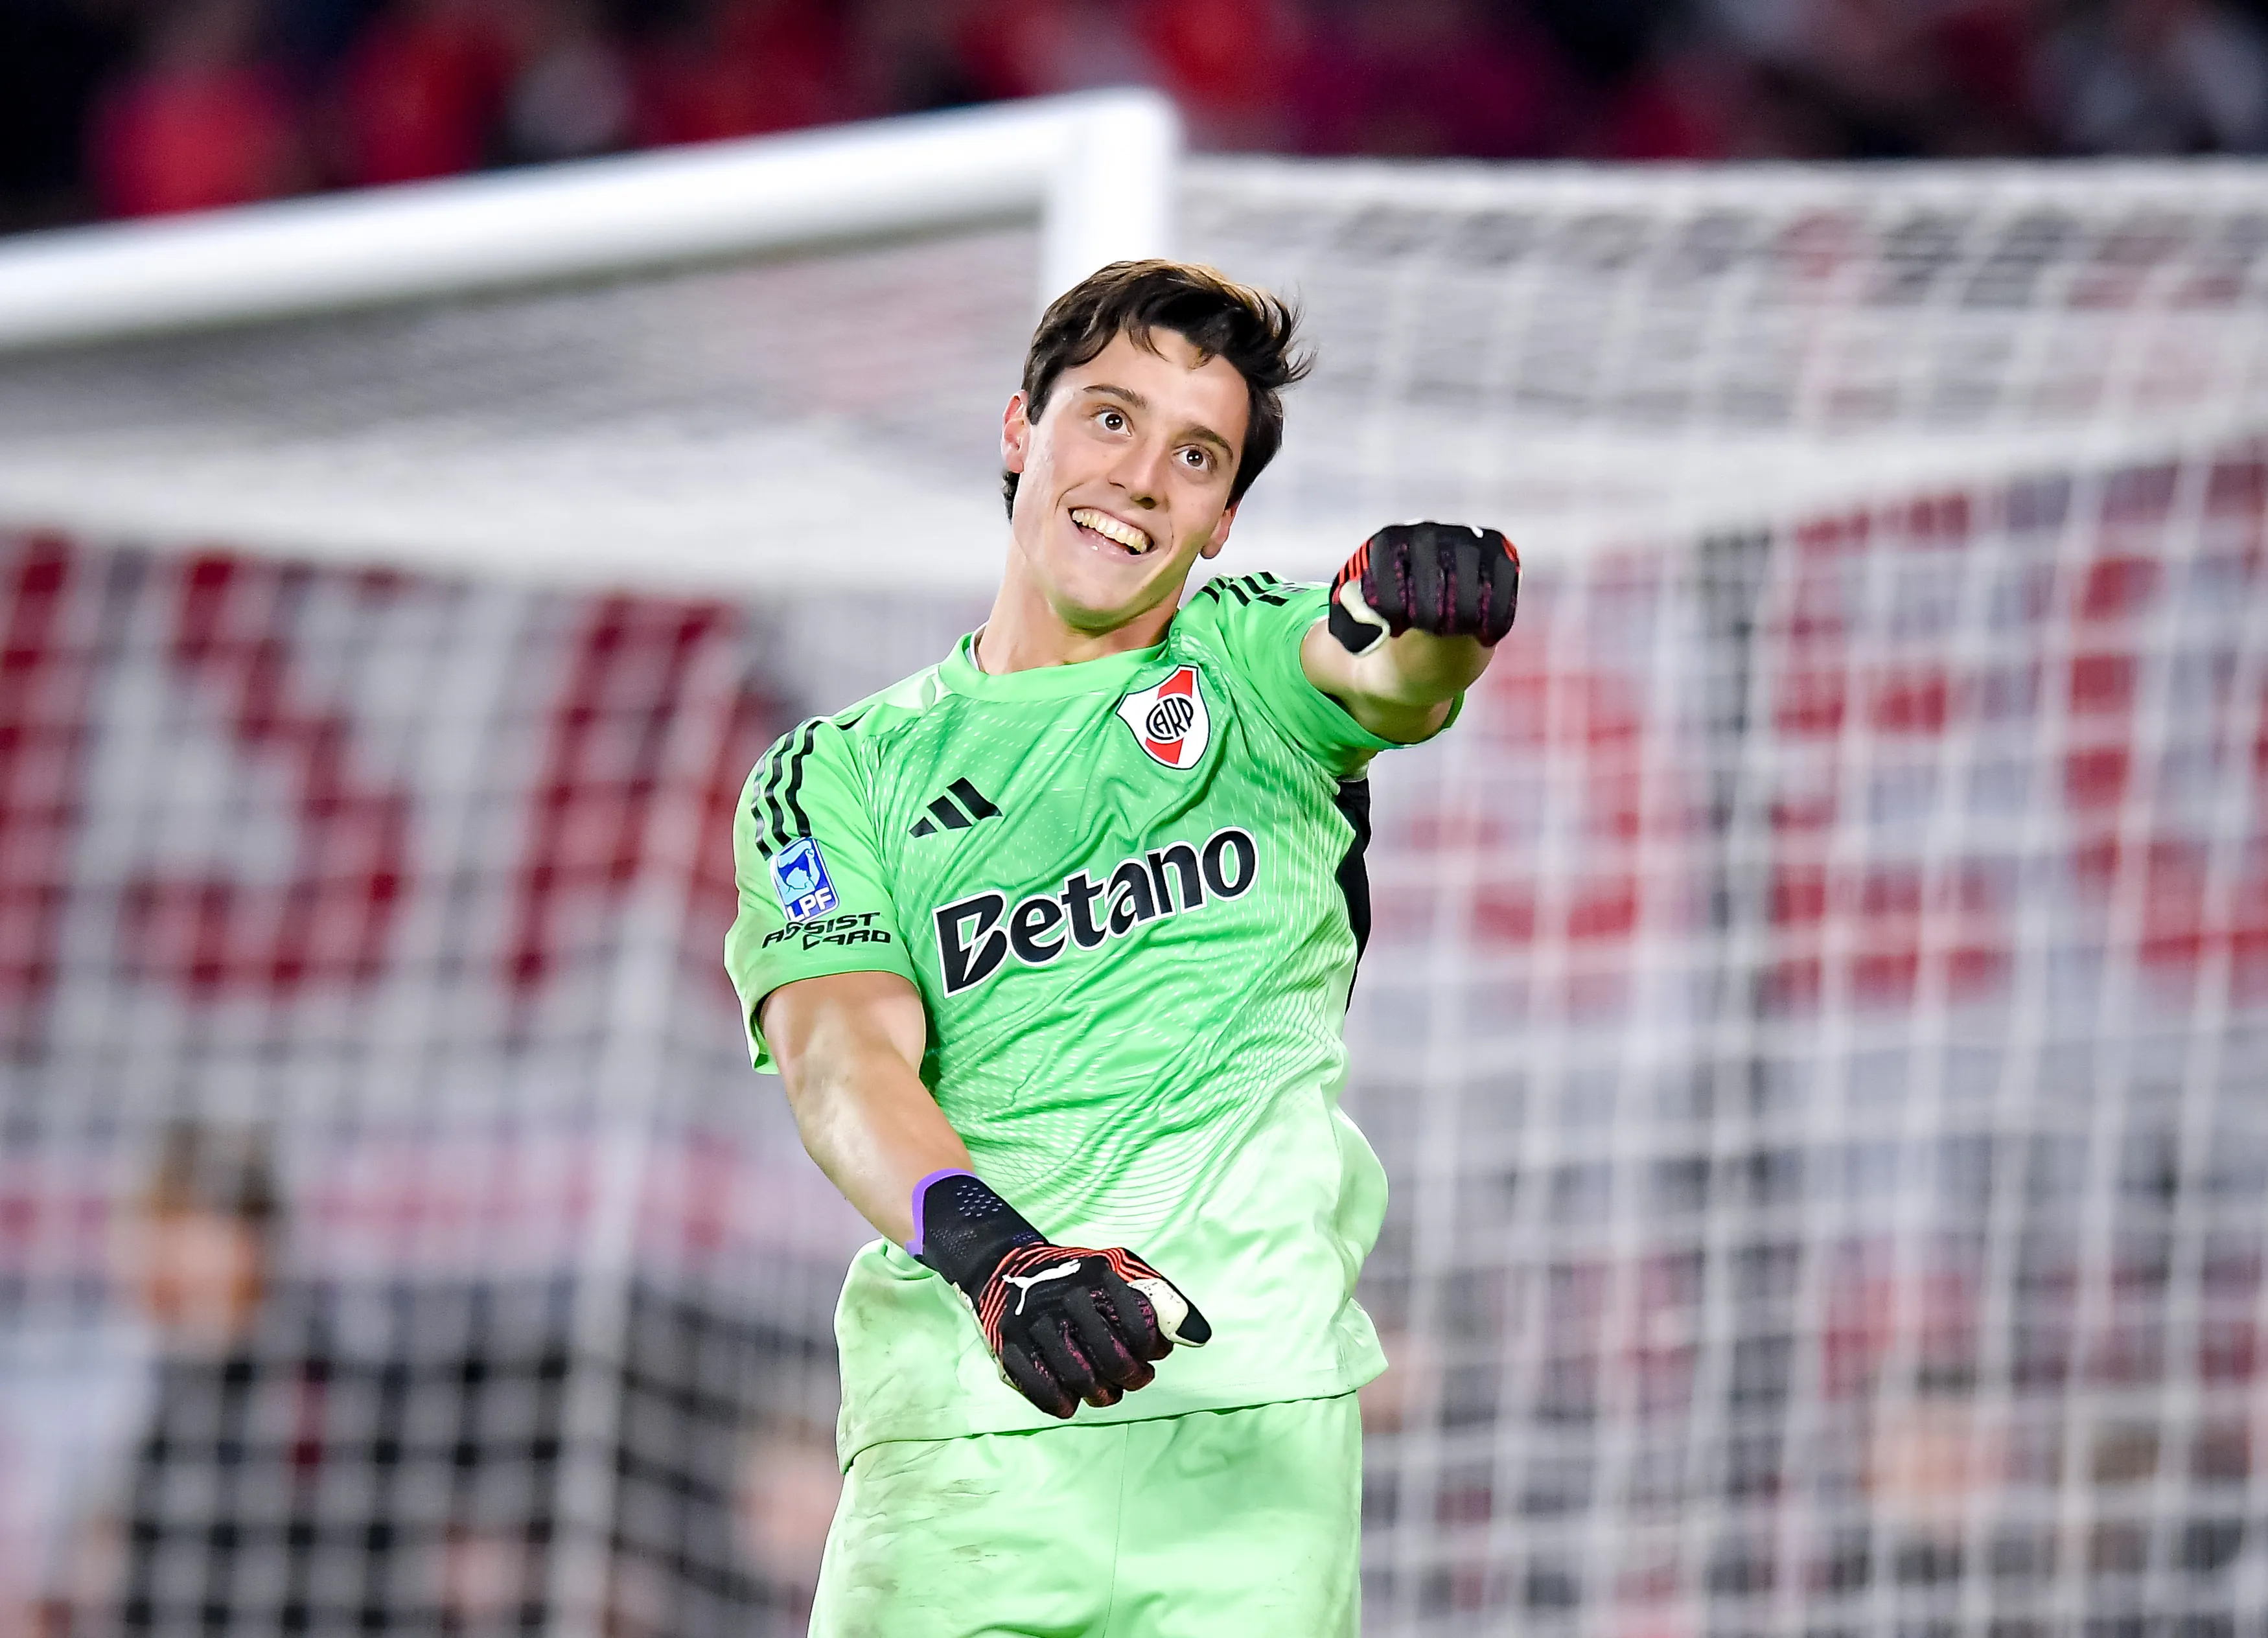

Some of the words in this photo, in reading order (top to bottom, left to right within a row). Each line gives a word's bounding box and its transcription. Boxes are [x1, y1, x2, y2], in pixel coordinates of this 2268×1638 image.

[1146, 697, 1194, 740] CARP
[787, 887, 832, 922] LPF
[932, 826, 1260, 998] Betano
[761, 912, 880, 949] ASSIST
[803, 929, 891, 951] CARD
